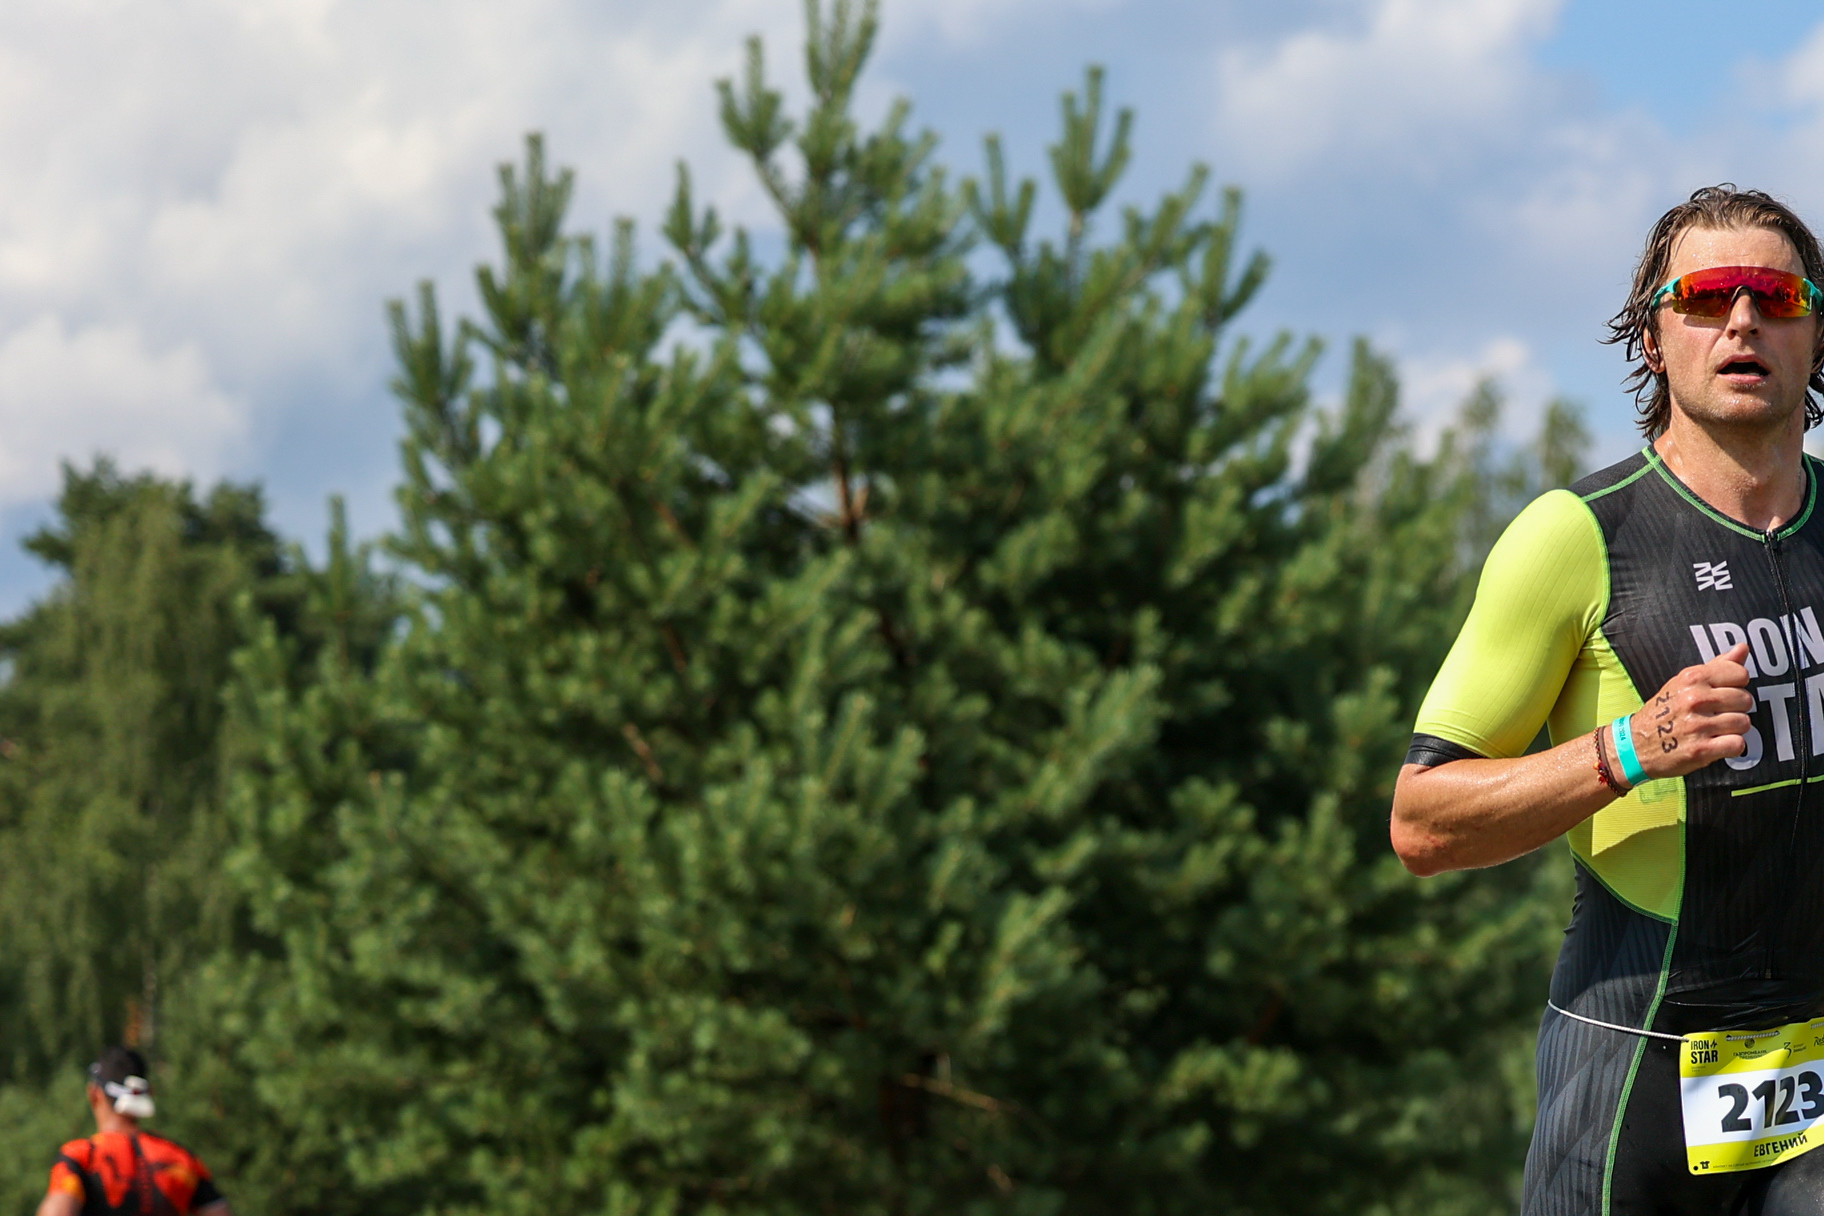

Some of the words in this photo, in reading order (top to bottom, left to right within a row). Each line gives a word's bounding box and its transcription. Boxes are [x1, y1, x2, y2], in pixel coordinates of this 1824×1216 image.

[1655, 691, 1679, 753] 2123
[1690, 1040, 1710, 1050] IRON
[1690, 1050, 1719, 1064] STAR
[1753, 1132, 1808, 1158] ЕВГЕНИЙ
